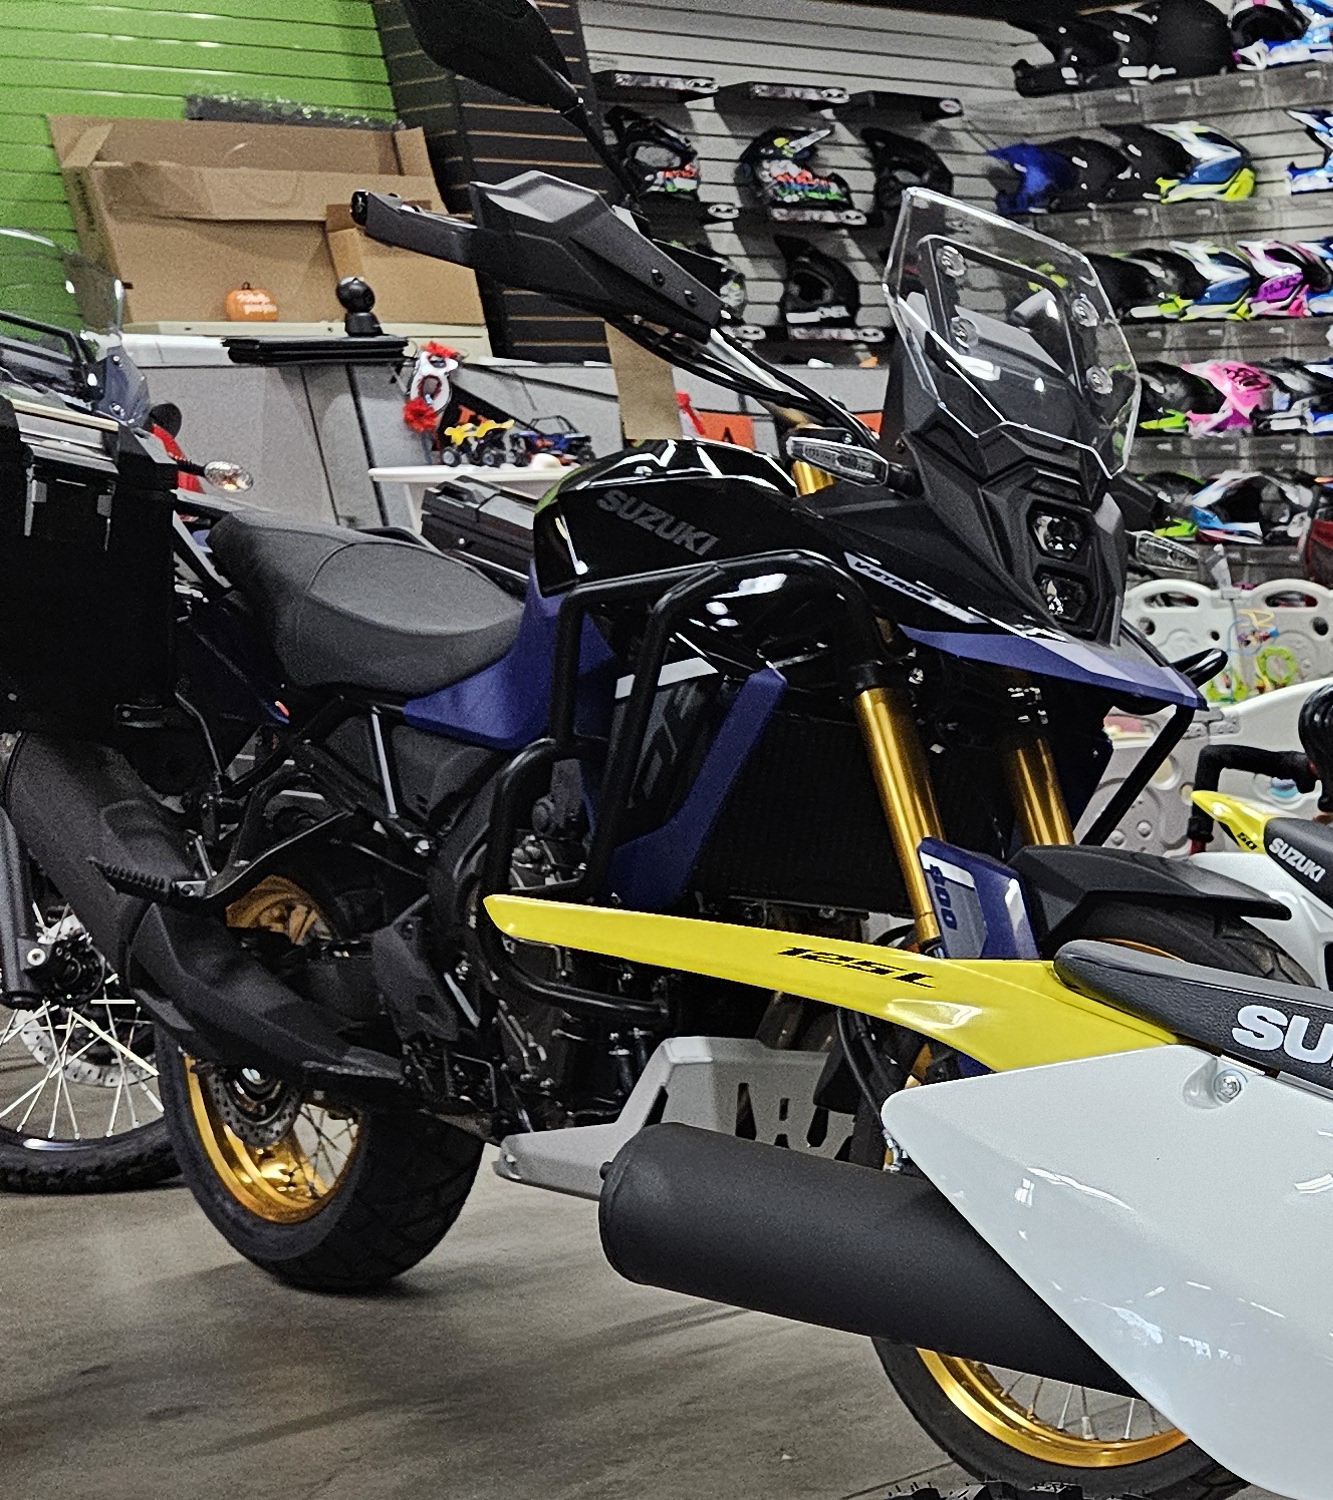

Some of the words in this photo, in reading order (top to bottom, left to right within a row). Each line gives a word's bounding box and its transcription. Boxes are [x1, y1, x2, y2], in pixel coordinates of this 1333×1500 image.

[597, 488, 721, 556] SUZUKI
[1268, 837, 1326, 883] SUZUKI
[778, 948, 936, 989] 125L
